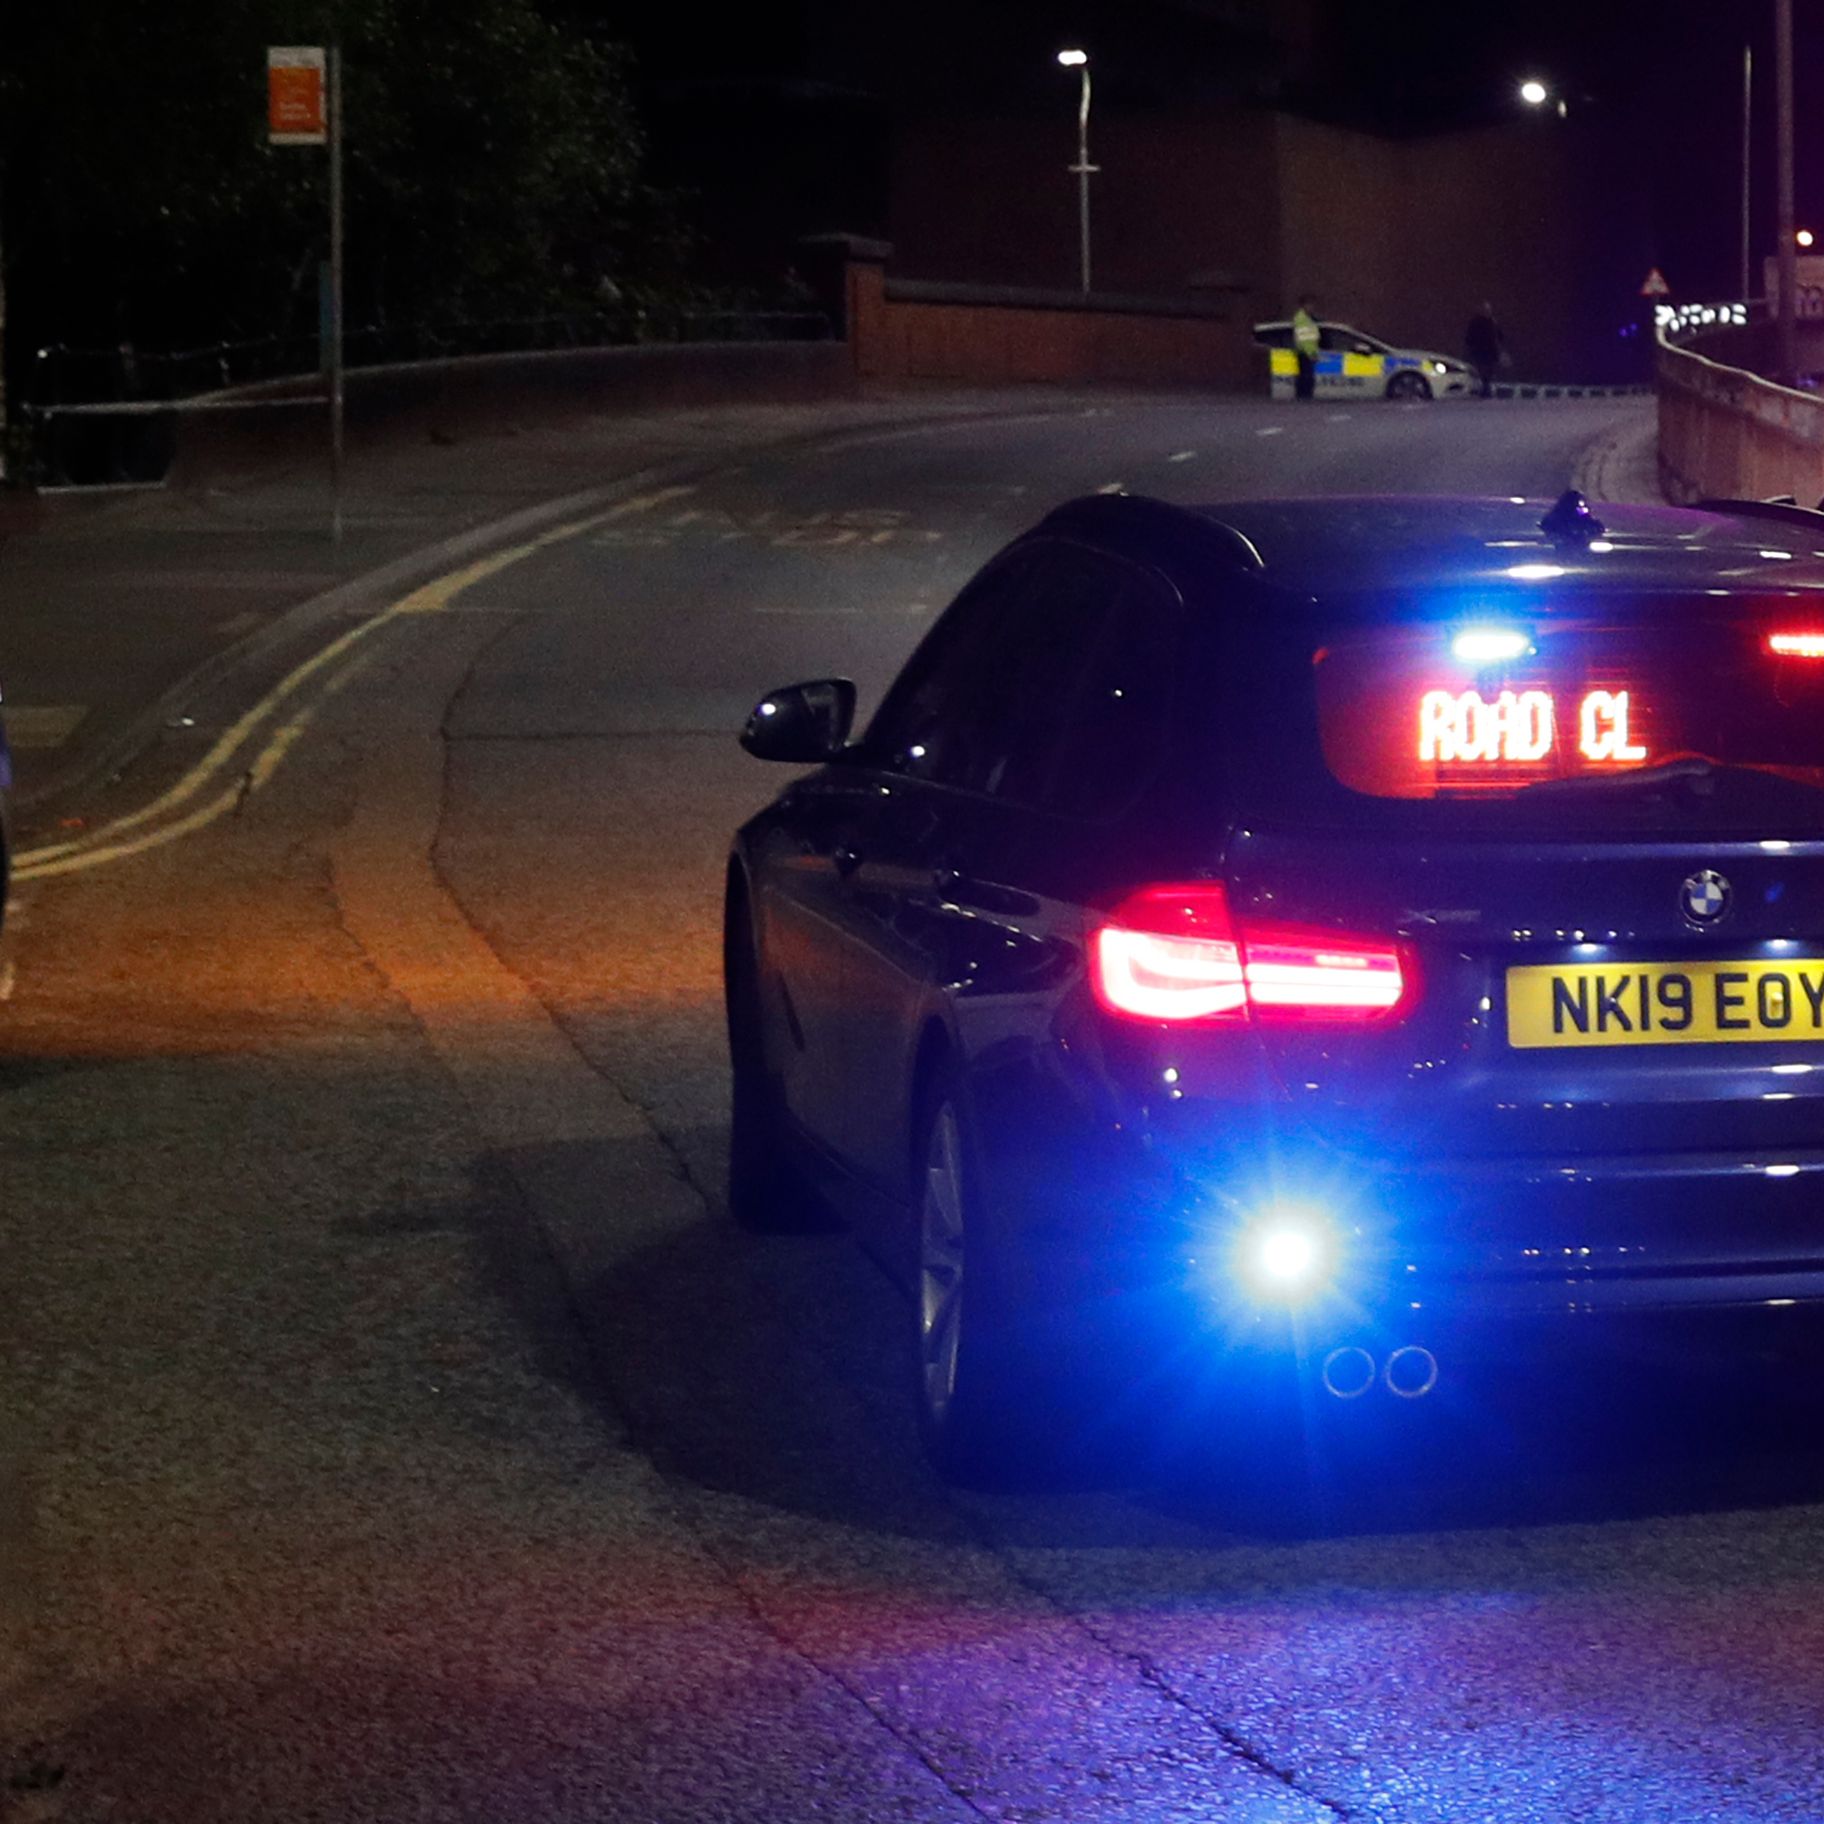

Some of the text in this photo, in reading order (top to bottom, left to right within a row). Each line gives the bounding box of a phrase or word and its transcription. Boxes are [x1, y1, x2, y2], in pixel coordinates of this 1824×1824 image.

[1420, 691, 1646, 762] ROAD CL
[1552, 976, 1693, 1034] NK19
